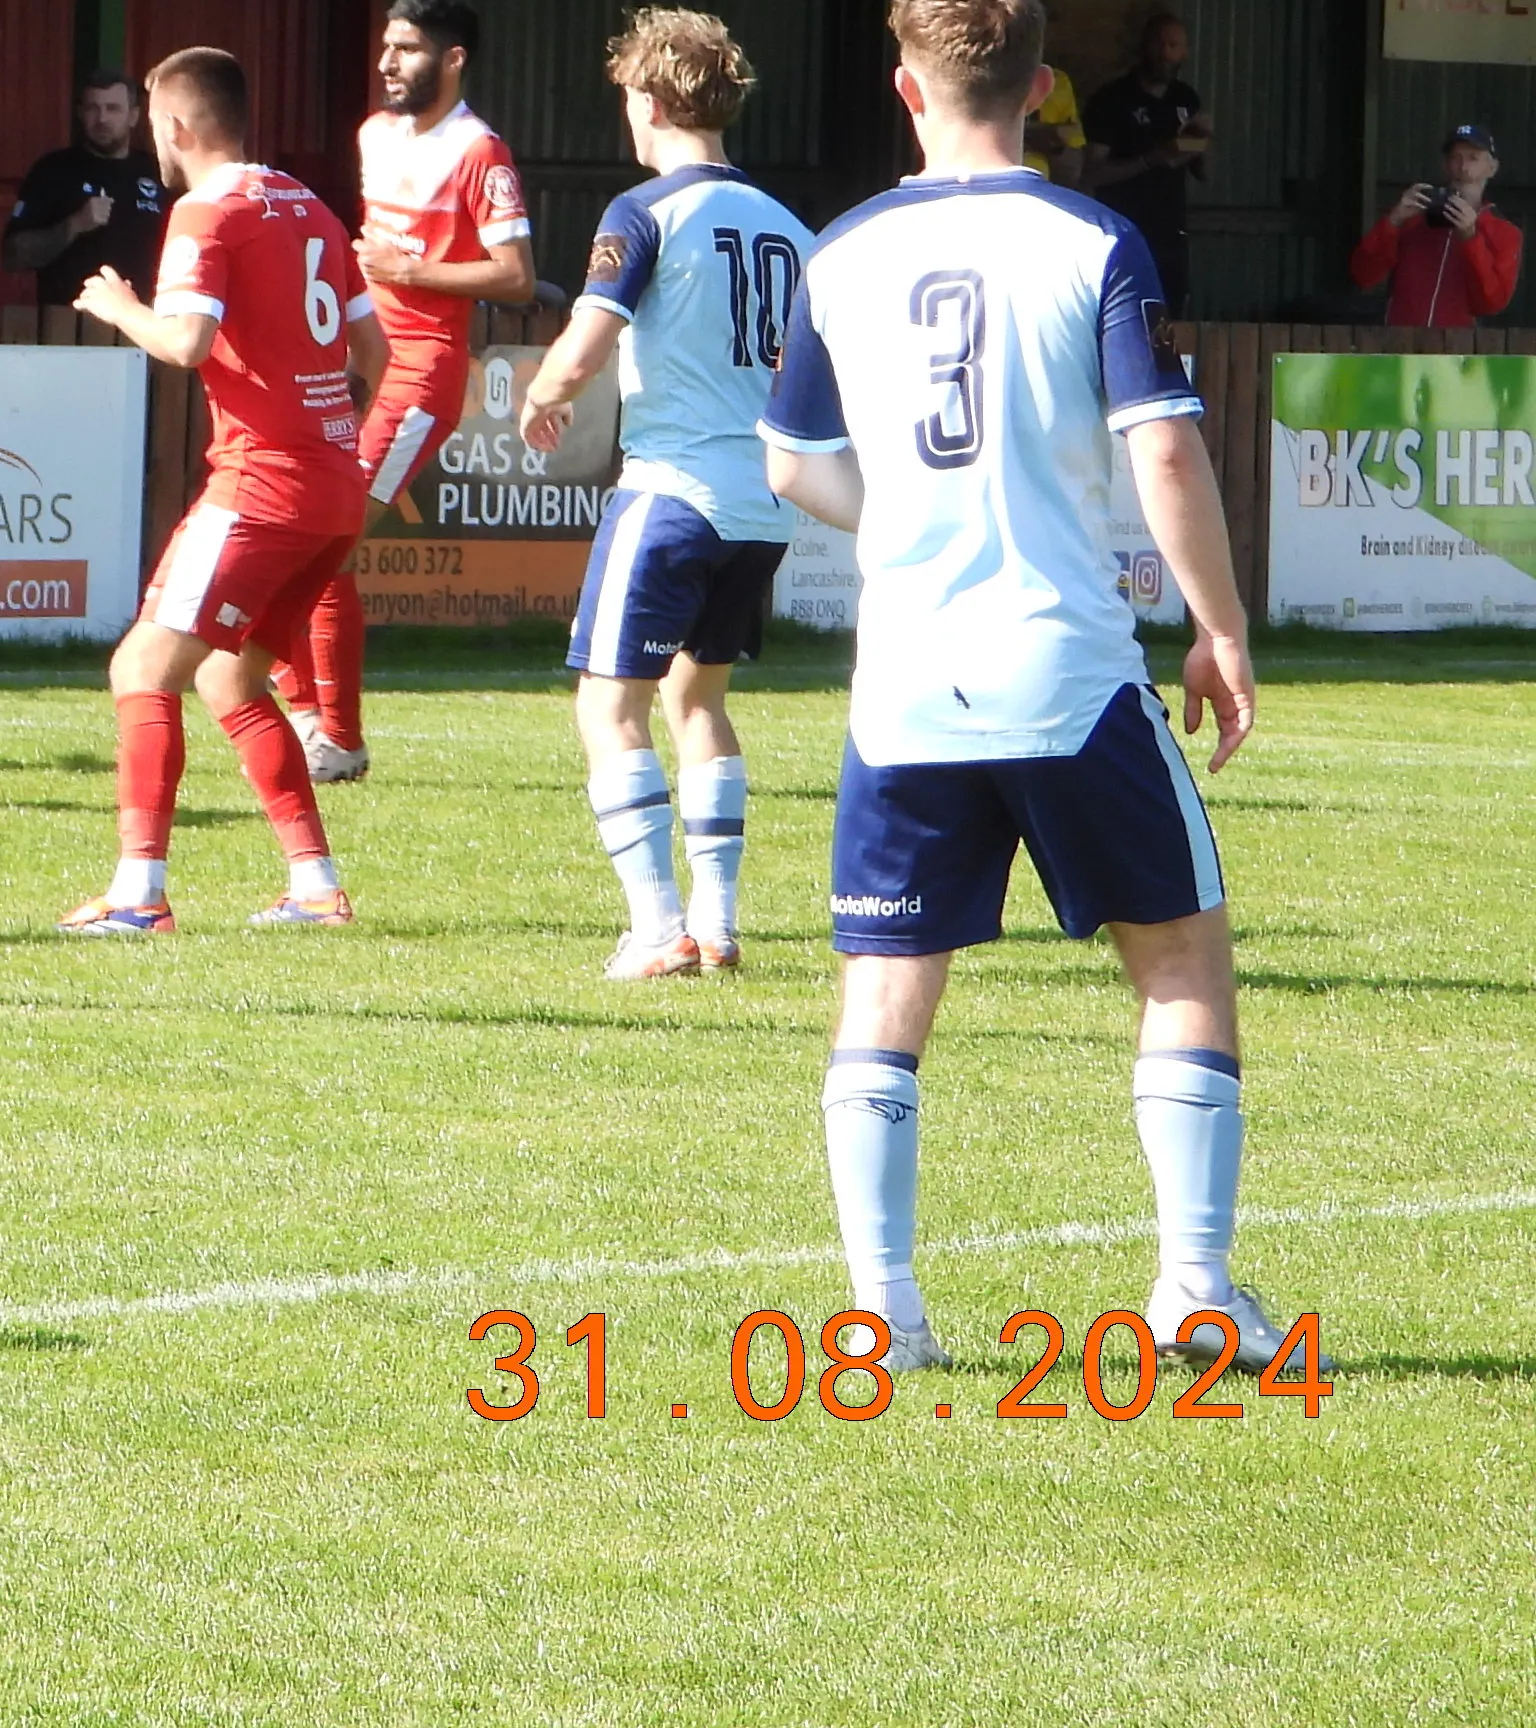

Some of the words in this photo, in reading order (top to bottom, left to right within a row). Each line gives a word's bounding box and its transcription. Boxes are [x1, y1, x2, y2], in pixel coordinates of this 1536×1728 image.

[305, 238, 340, 346] 6
[713, 227, 801, 369] 10
[909, 268, 985, 470] 3
[438, 432, 513, 476] GAS
[521, 447, 547, 475] &
[1298, 428, 1423, 509] BK'S
[378, 546, 418, 575] 600
[424, 546, 463, 575] 372
[1361, 534, 1390, 557] Brain
[1393, 536, 1413, 557] and
[1416, 535, 1455, 561] Kidney
[362, 584, 582, 621] enyon@hotmail.co.u
